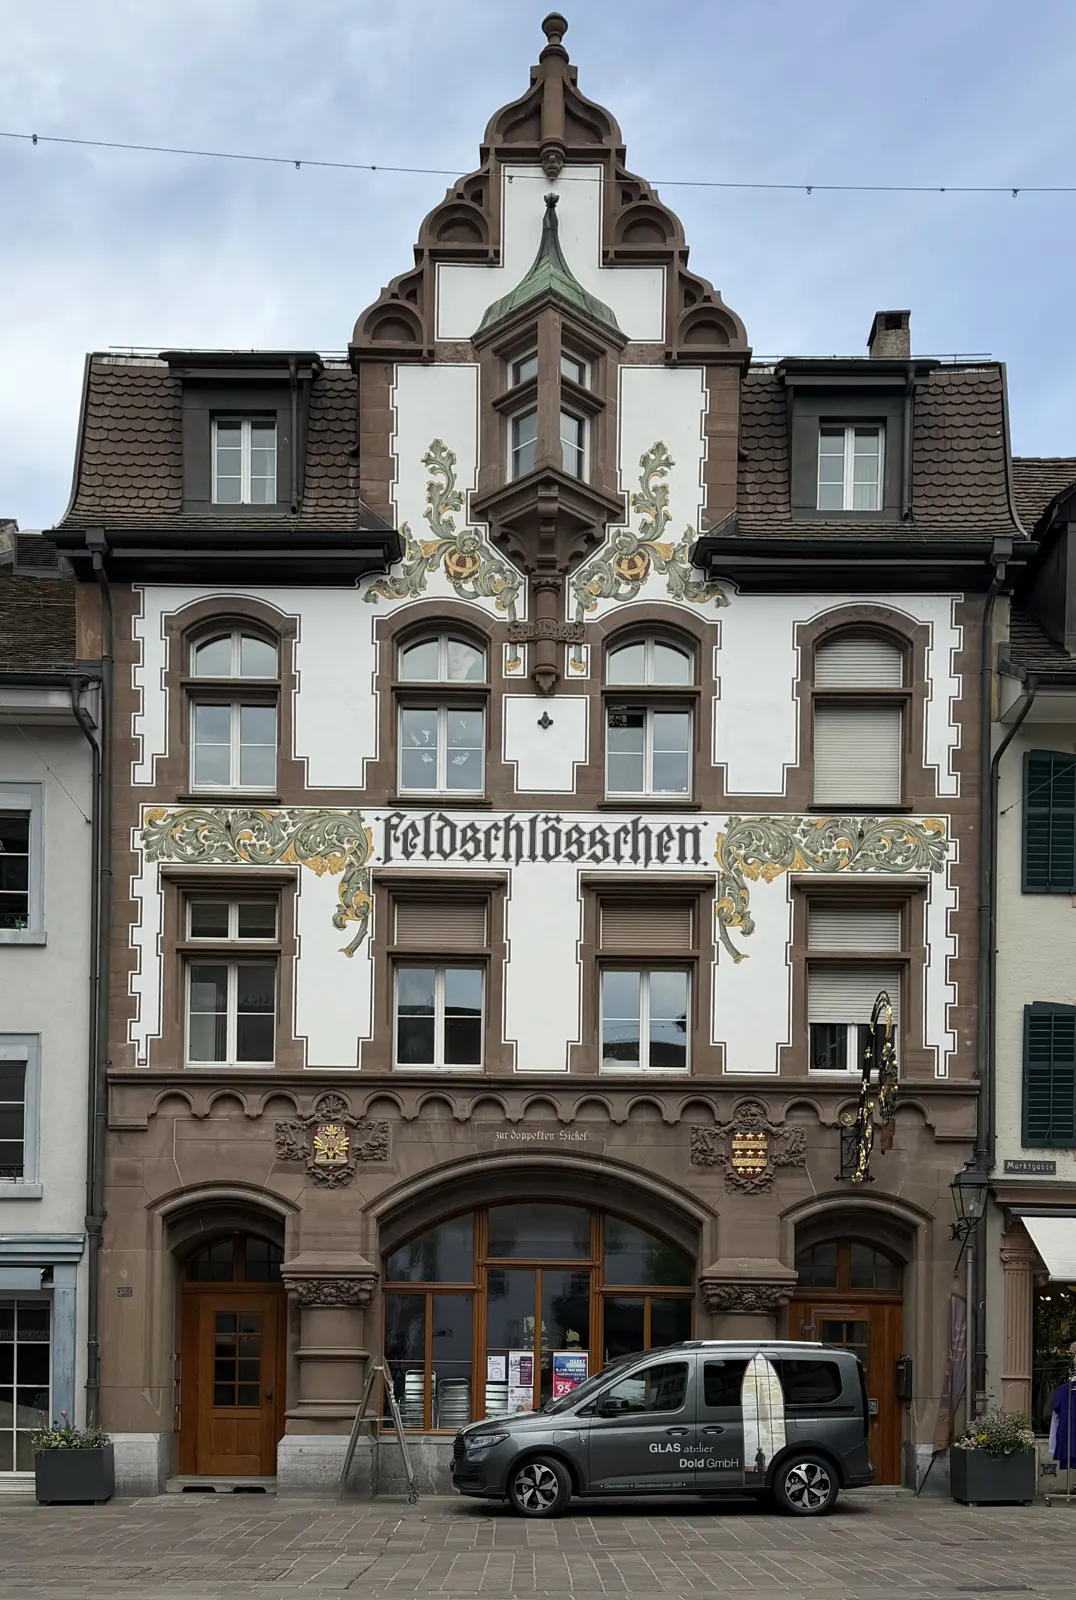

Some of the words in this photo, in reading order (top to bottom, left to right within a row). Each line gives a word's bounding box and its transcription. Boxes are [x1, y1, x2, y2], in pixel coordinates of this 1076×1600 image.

[382, 811, 703, 868] Feldschlösschen
[495, 1131, 508, 1141] zur
[560, 1130, 588, 1141] Sichel
[1007, 1162, 1054, 1171] Marktgasse
[557, 1384, 571, 1394] 95
[649, 1443, 681, 1453] GLAS
[683, 1442, 714, 1453] atelier
[680, 1458, 704, 1468] Dold
[706, 1458, 739, 1468] GmbH
